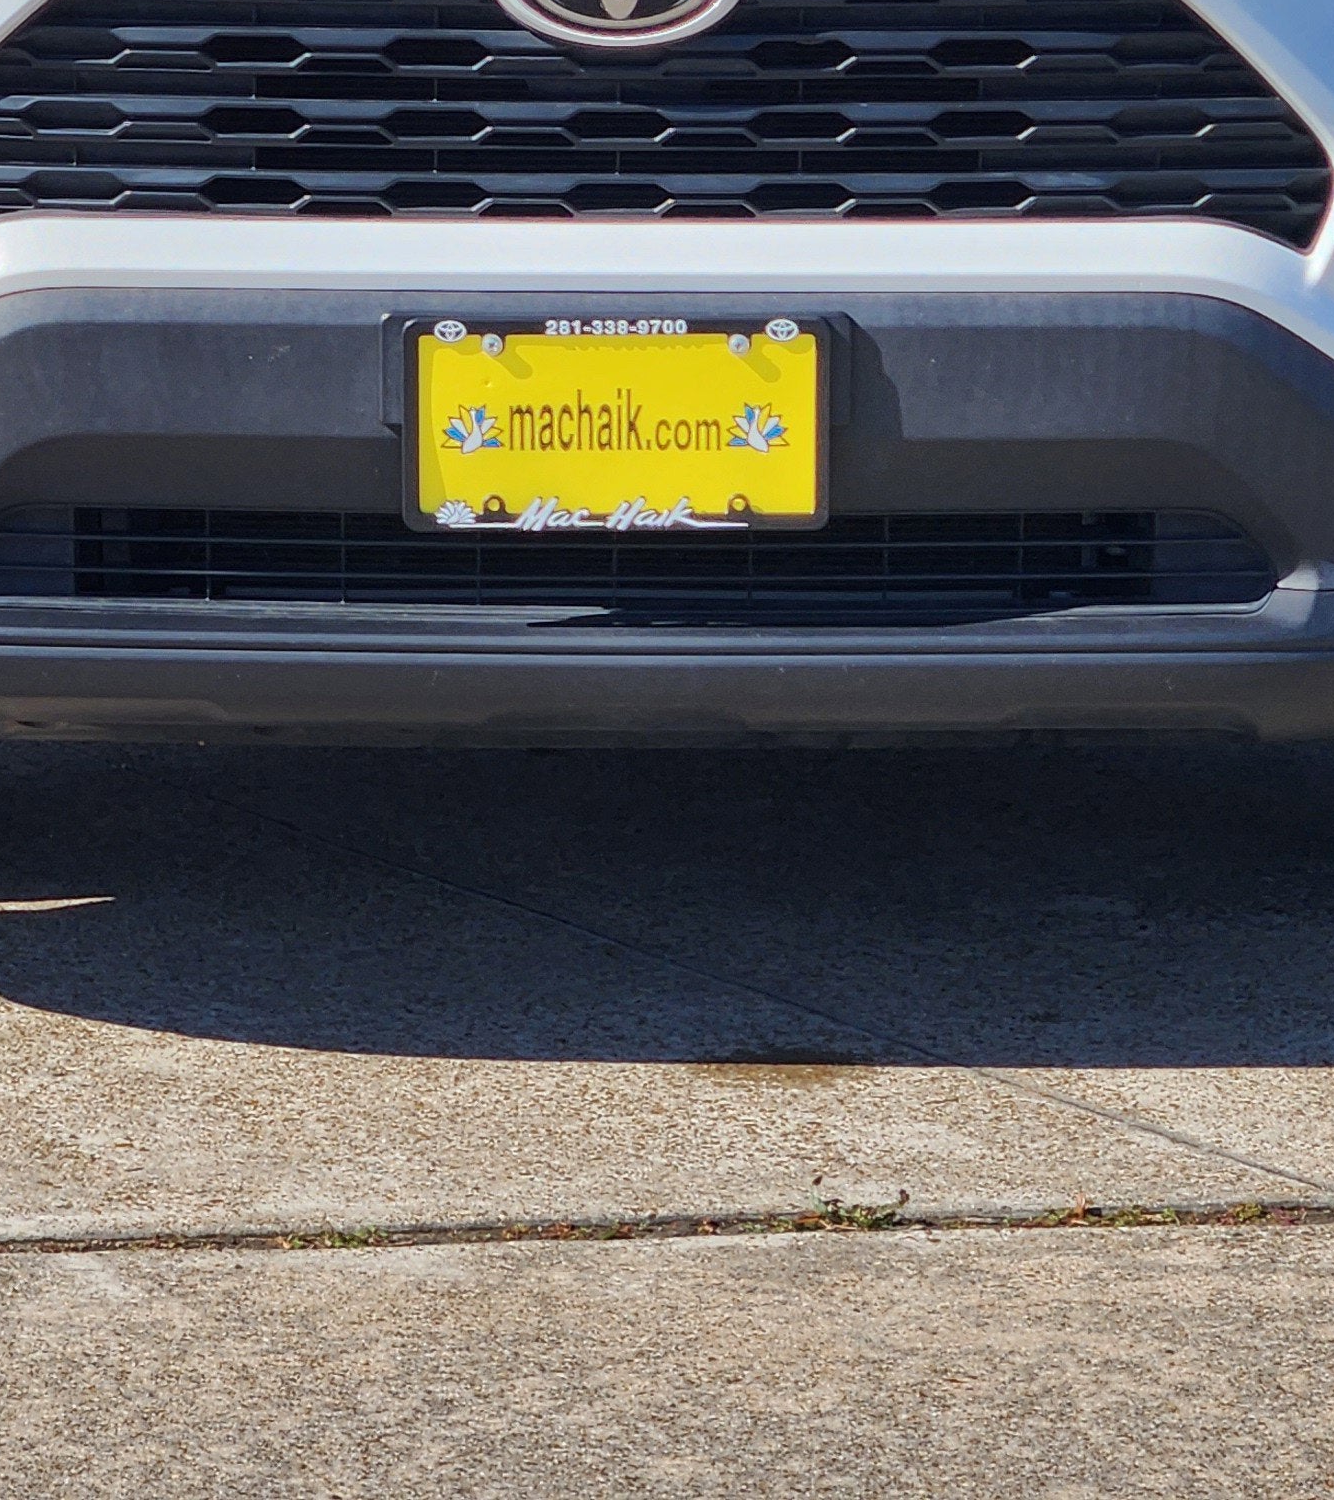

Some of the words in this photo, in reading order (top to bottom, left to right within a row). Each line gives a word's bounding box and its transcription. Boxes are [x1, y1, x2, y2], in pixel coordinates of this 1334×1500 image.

[545, 319, 688, 335] 281-338-9700
[508, 388, 722, 452] machaik.com
[515, 496, 599, 531] Mac
[604, 496, 701, 531] Haik
